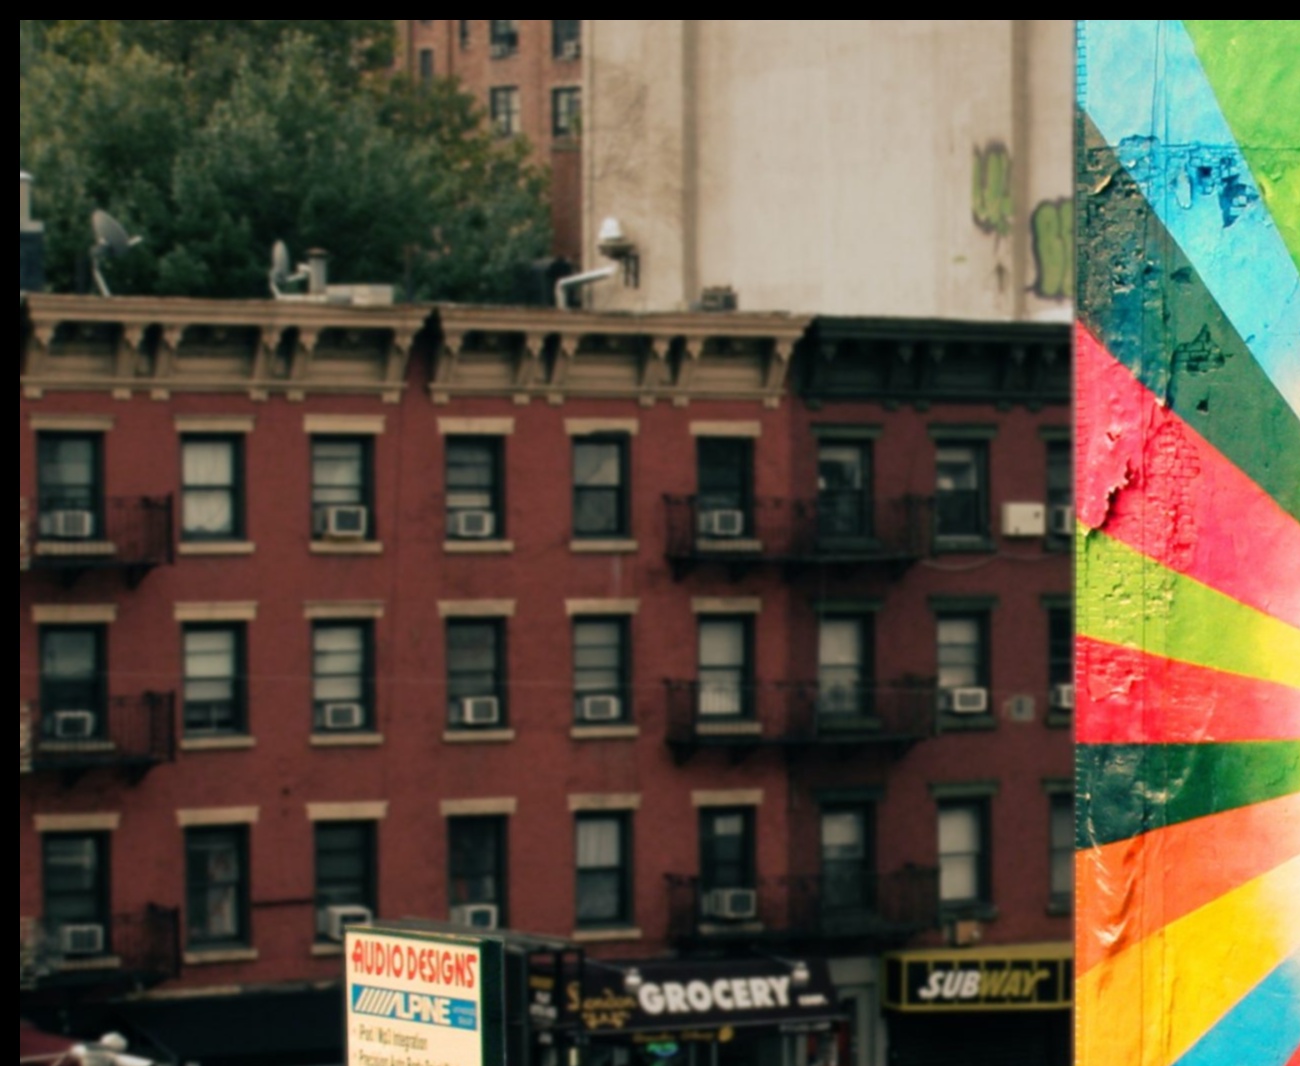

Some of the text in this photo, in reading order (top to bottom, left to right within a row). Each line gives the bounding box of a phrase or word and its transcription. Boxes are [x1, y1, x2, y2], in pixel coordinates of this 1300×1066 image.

[351, 939, 477, 989] AUDIO DESIGNS
[918, 968, 1050, 999] SUBWAY
[638, 975, 790, 1015] GROCERY
